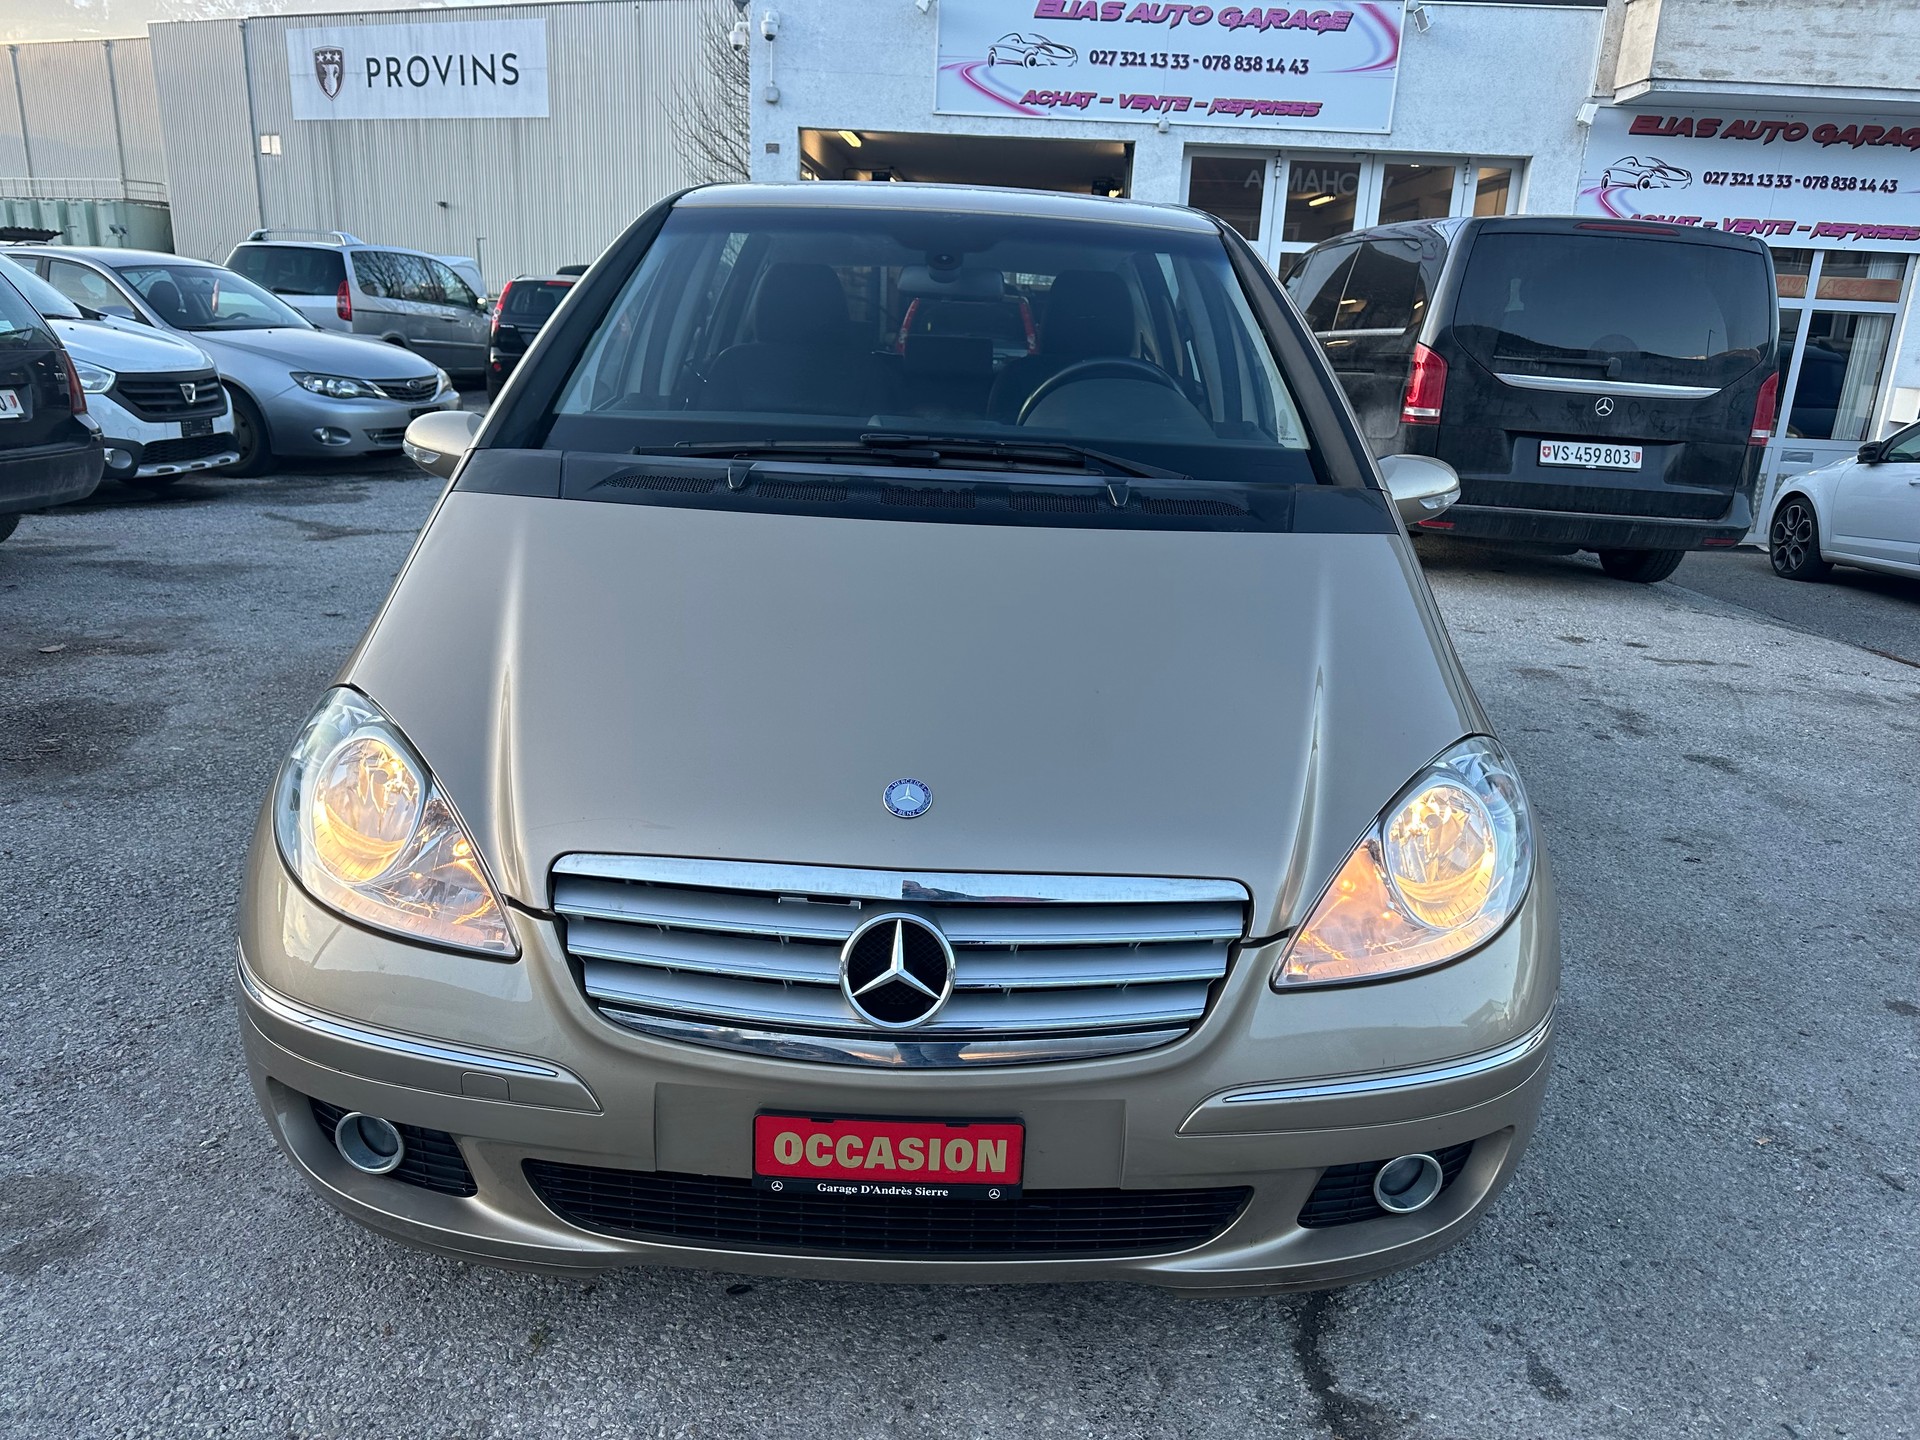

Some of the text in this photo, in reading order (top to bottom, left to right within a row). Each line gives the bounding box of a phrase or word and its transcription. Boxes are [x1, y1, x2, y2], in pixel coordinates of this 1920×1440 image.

[1034, 0, 1354, 36] ELIAS AUTO GARAGE
[366, 52, 519, 88] PROVINS
[1089, 50, 1117, 66] 027
[1119, 51, 1147, 67] 321
[1150, 53, 1168, 69] 13
[1171, 54, 1190, 69] 33
[1202, 55, 1231, 71] 078
[1234, 55, 1263, 72] 838
[1266, 58, 1286, 74] 14
[1288, 58, 1310, 75] 43
[1019, 89, 1098, 110] ACHAT
[1119, 93, 1192, 114] VENTE
[1207, 97, 1323, 118] REPRISES
[1629, 115, 1920, 152] ELIAS AUTO GARAG
[1703, 171, 1729, 186] 027
[1729, 172, 1753, 187] 321
[1757, 173, 1774, 188] 13
[1775, 174, 1793, 189] 33
[1802, 175, 1829, 190] 078
[1831, 176, 1857, 191] 838
[1859, 178, 1877, 193] 14
[1879, 179, 1899, 193] 43
[1723, 217, 1797, 238] VENTE
[1809, 221, 1920, 241] REPRISES
[773, 1131, 1007, 1173] OCCASION
[817, 1183, 858, 1195] Garage
[914, 1186, 949, 1197] Sierre
